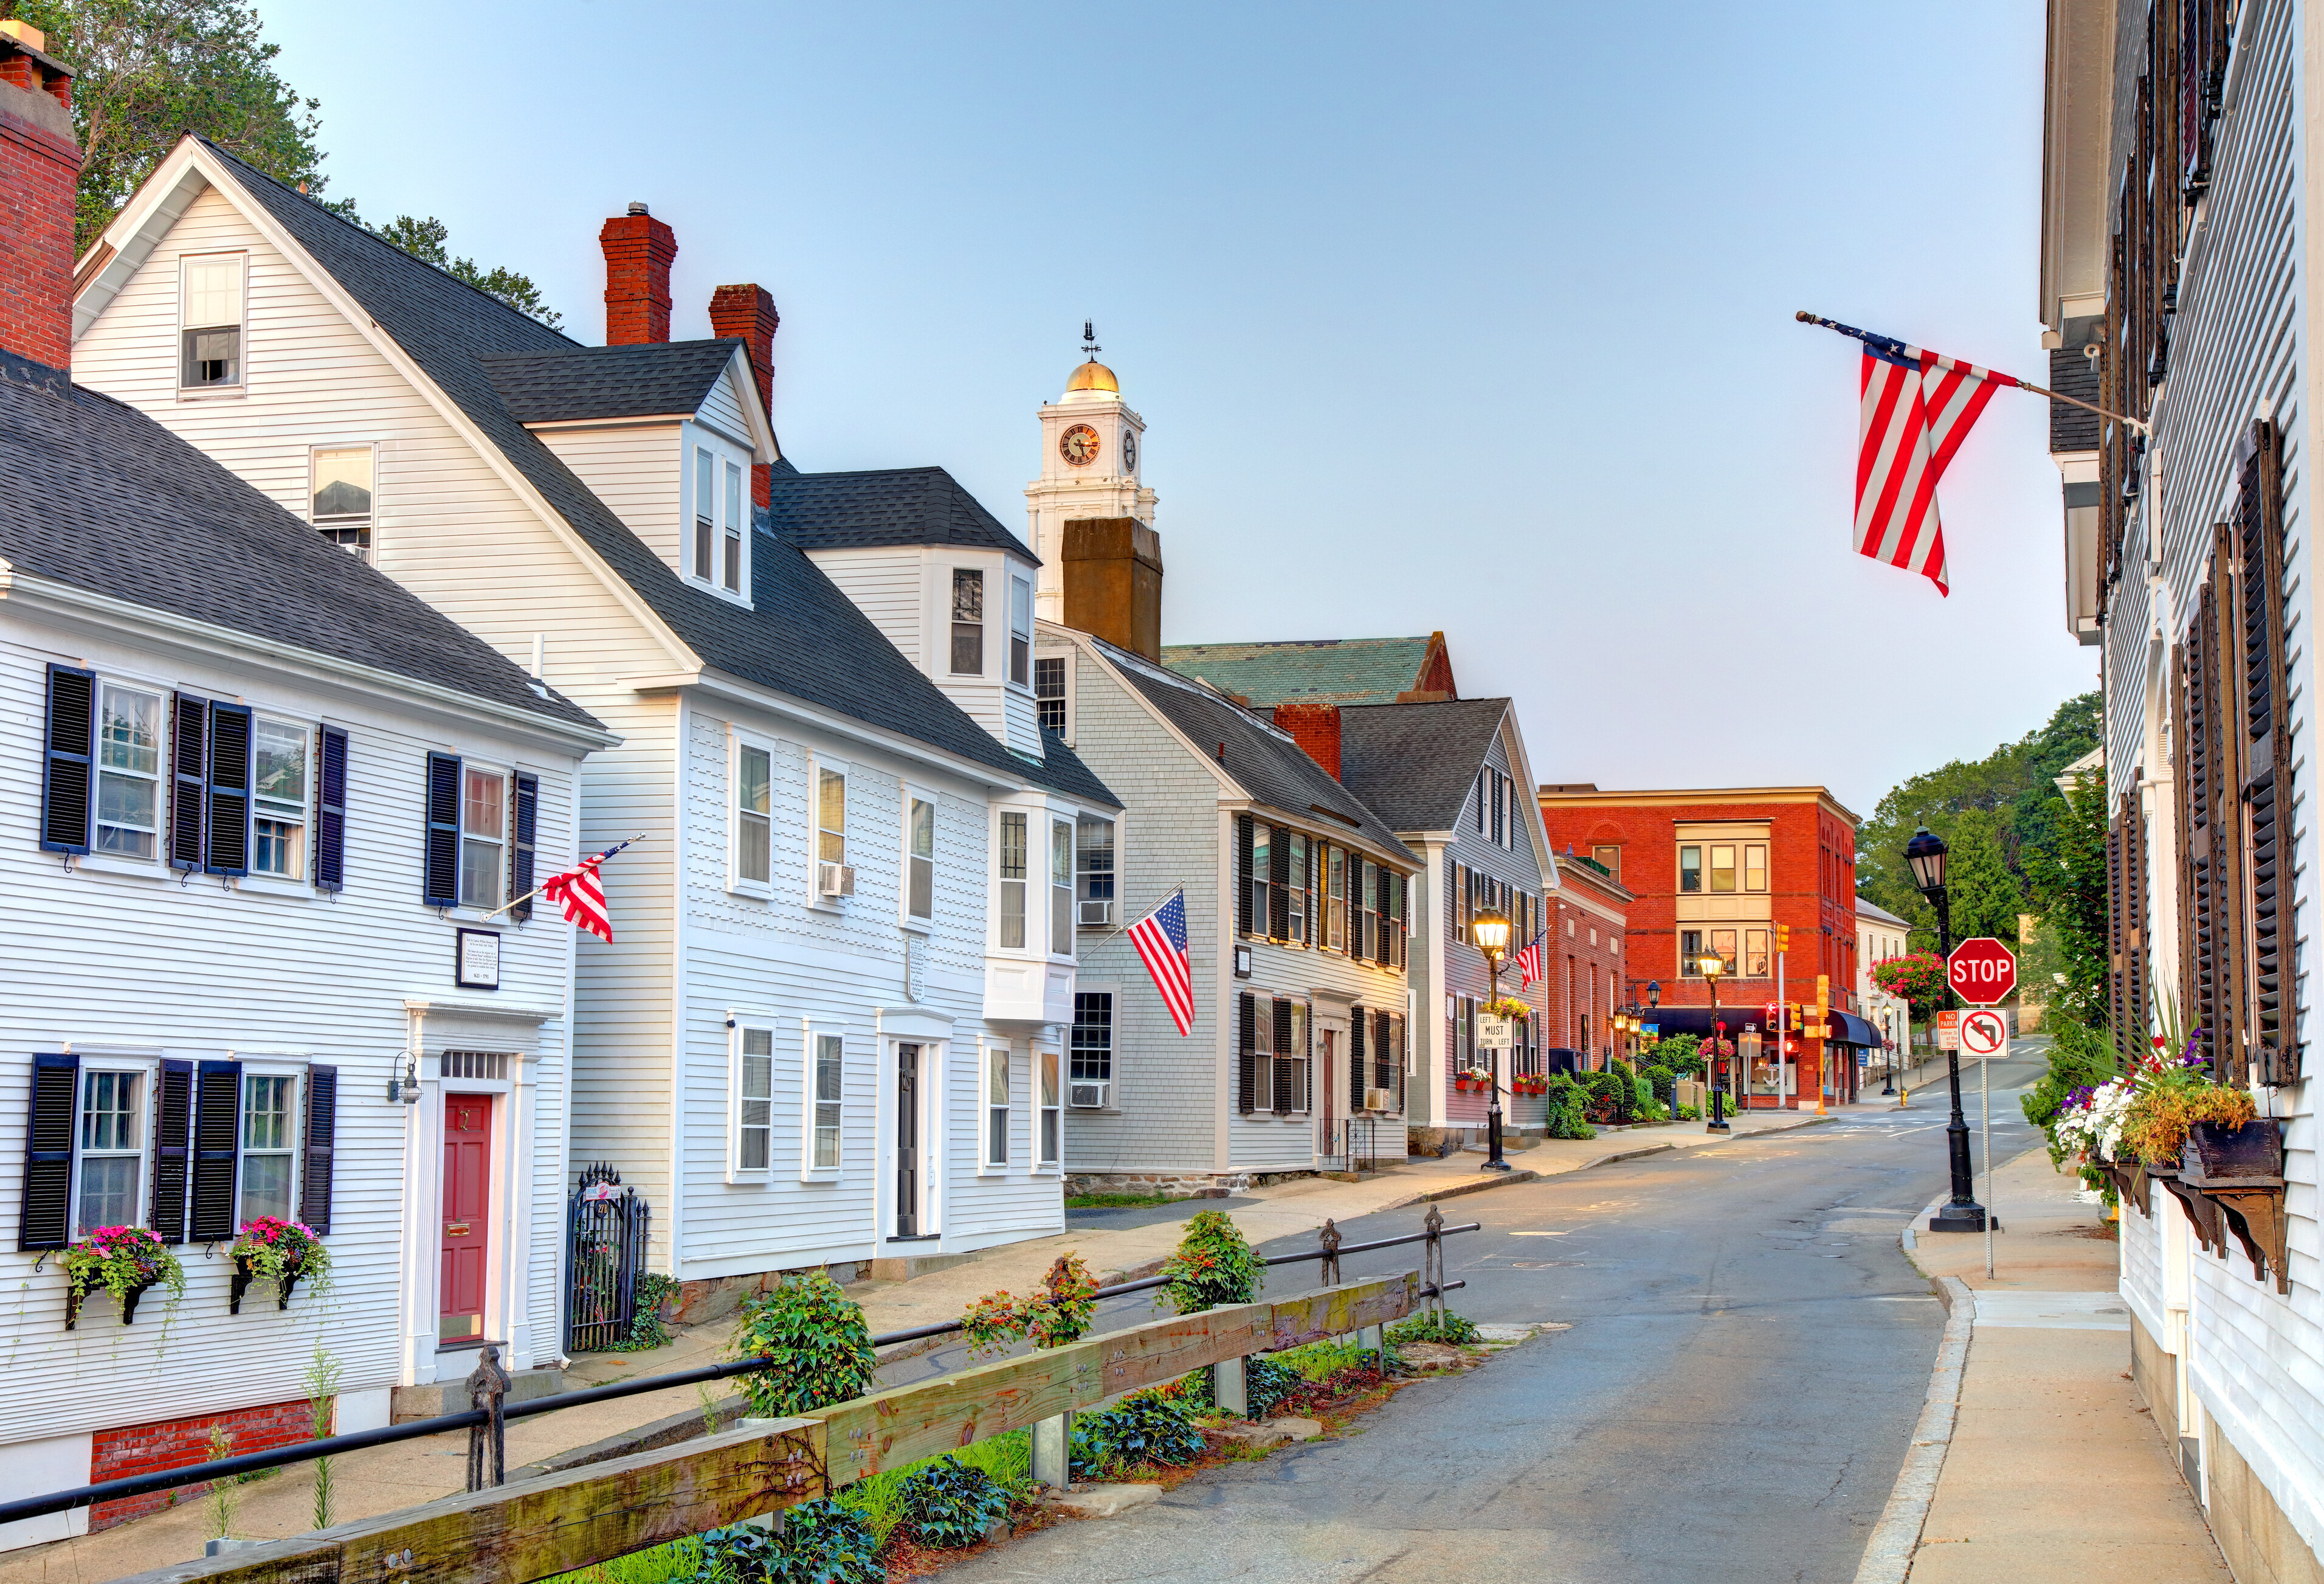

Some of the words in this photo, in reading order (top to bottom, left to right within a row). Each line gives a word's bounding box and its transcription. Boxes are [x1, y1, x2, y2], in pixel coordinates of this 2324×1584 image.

[1954, 960, 2010, 983] STOP
[1486, 1026, 1503, 1035] MUST
[598, 1204, 608, 1213] 27B
